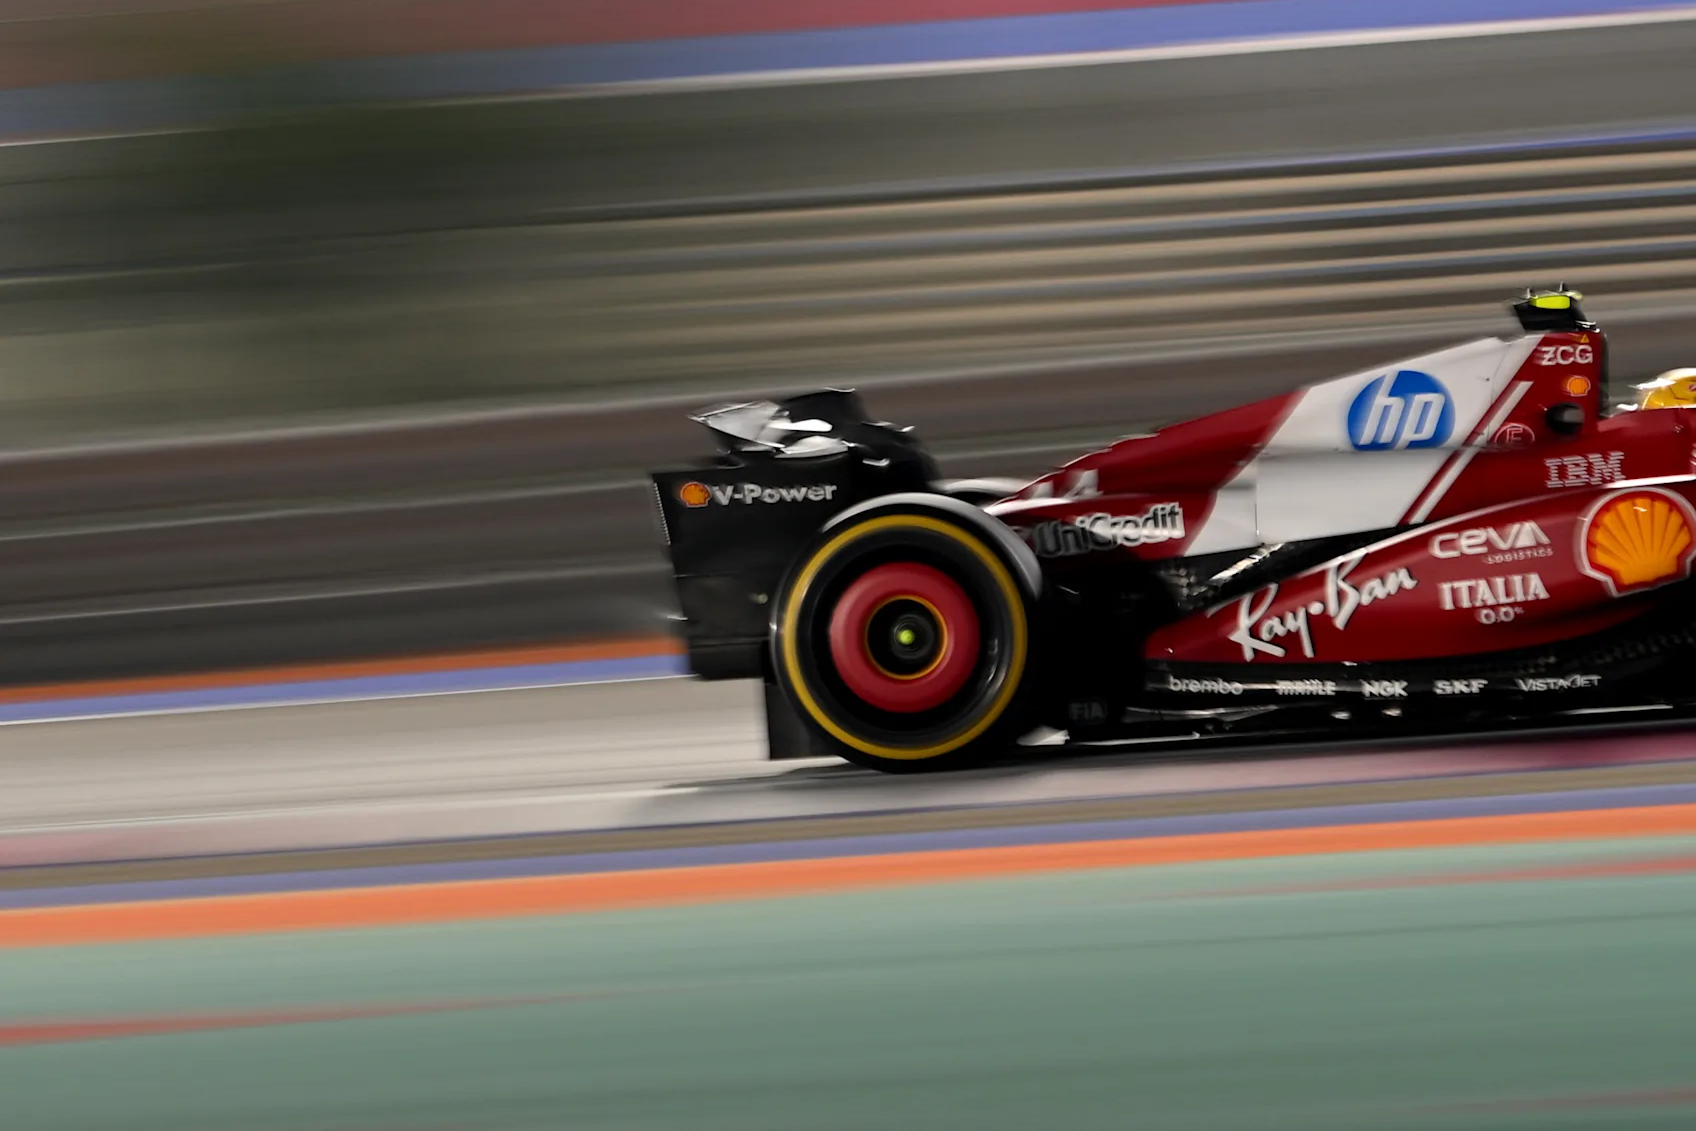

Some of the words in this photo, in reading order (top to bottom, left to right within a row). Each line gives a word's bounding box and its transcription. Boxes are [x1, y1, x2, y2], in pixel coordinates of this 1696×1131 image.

[1359, 370, 1445, 449] hp
[1544, 451, 1626, 488] IBM
[712, 484, 837, 506] V-Power
[1034, 502, 1185, 557] UniCredit
[1483, 547, 1554, 564] LOGISTICS
[1437, 573, 1550, 610] ITALIA
[1168, 674, 1244, 696] brembo
[1360, 678, 1408, 697] NGK
[1433, 678, 1488, 695] SKF
